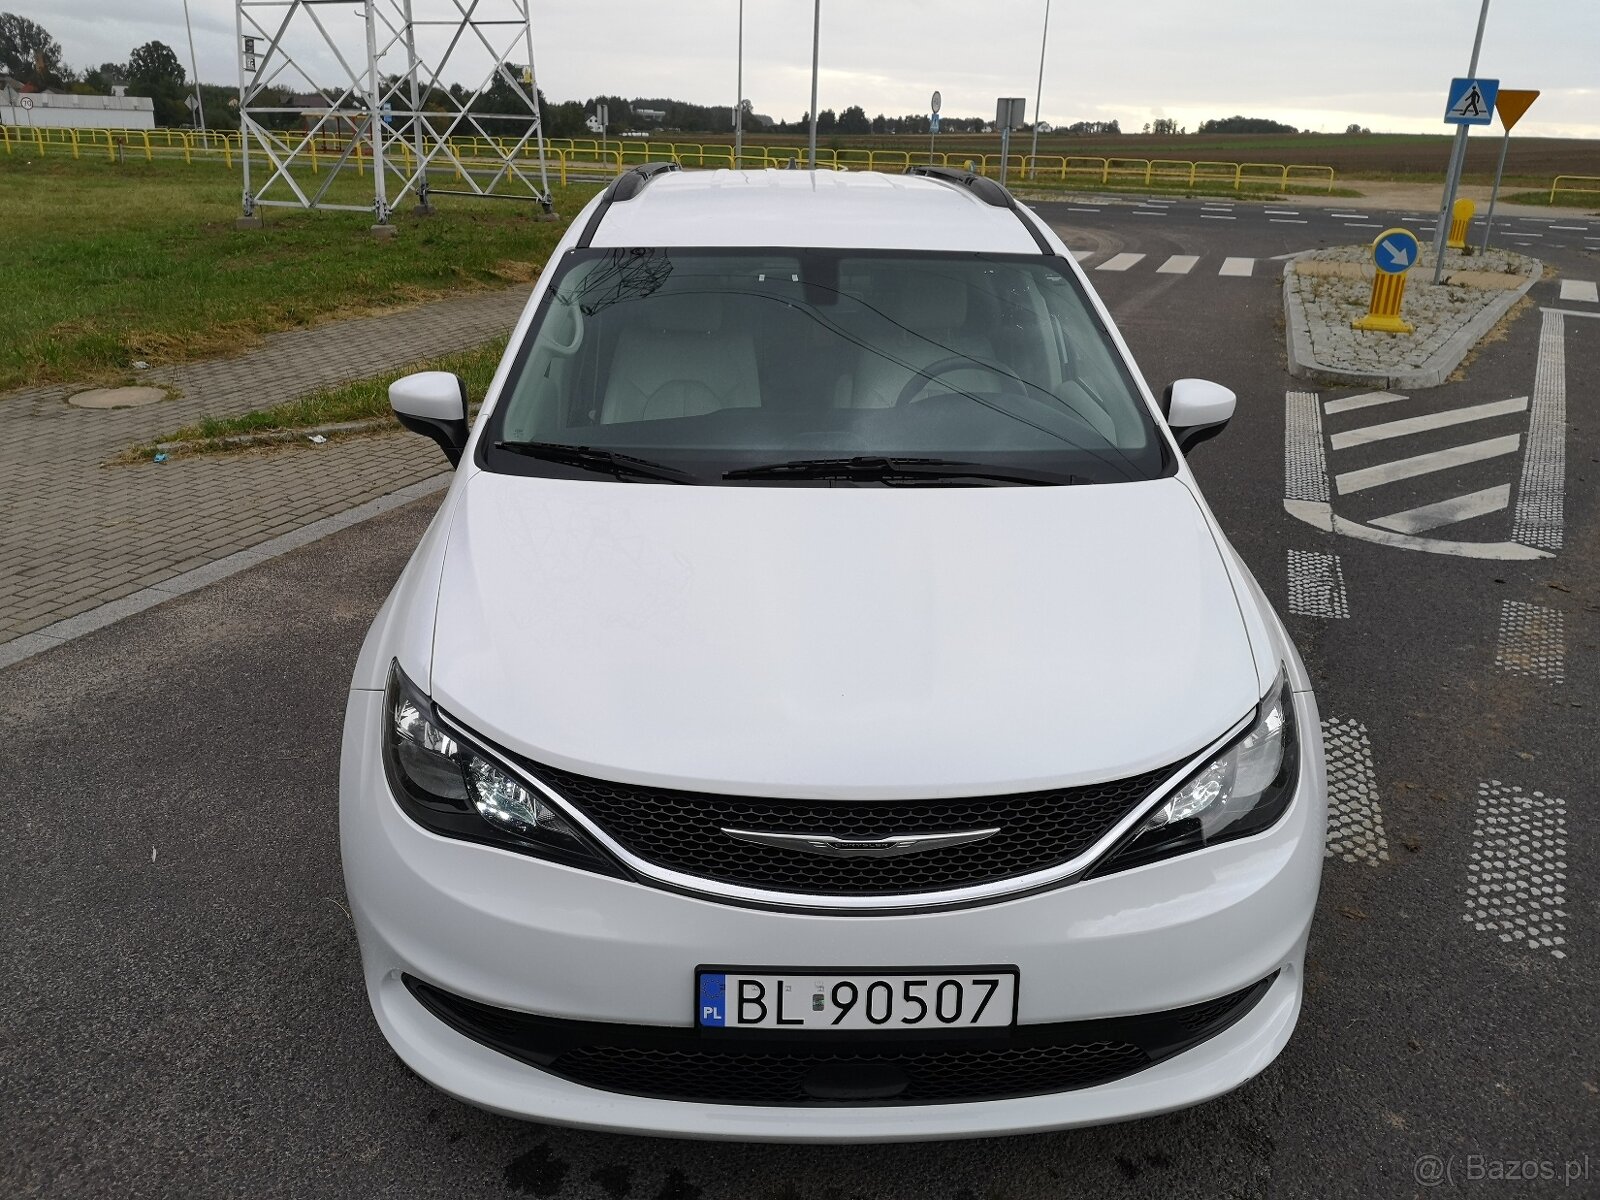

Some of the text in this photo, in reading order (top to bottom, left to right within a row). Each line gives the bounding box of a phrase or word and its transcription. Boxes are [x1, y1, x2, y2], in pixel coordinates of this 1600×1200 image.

[703, 1006, 722, 1020] PL
[737, 979, 1000, 1025] BL 90507
